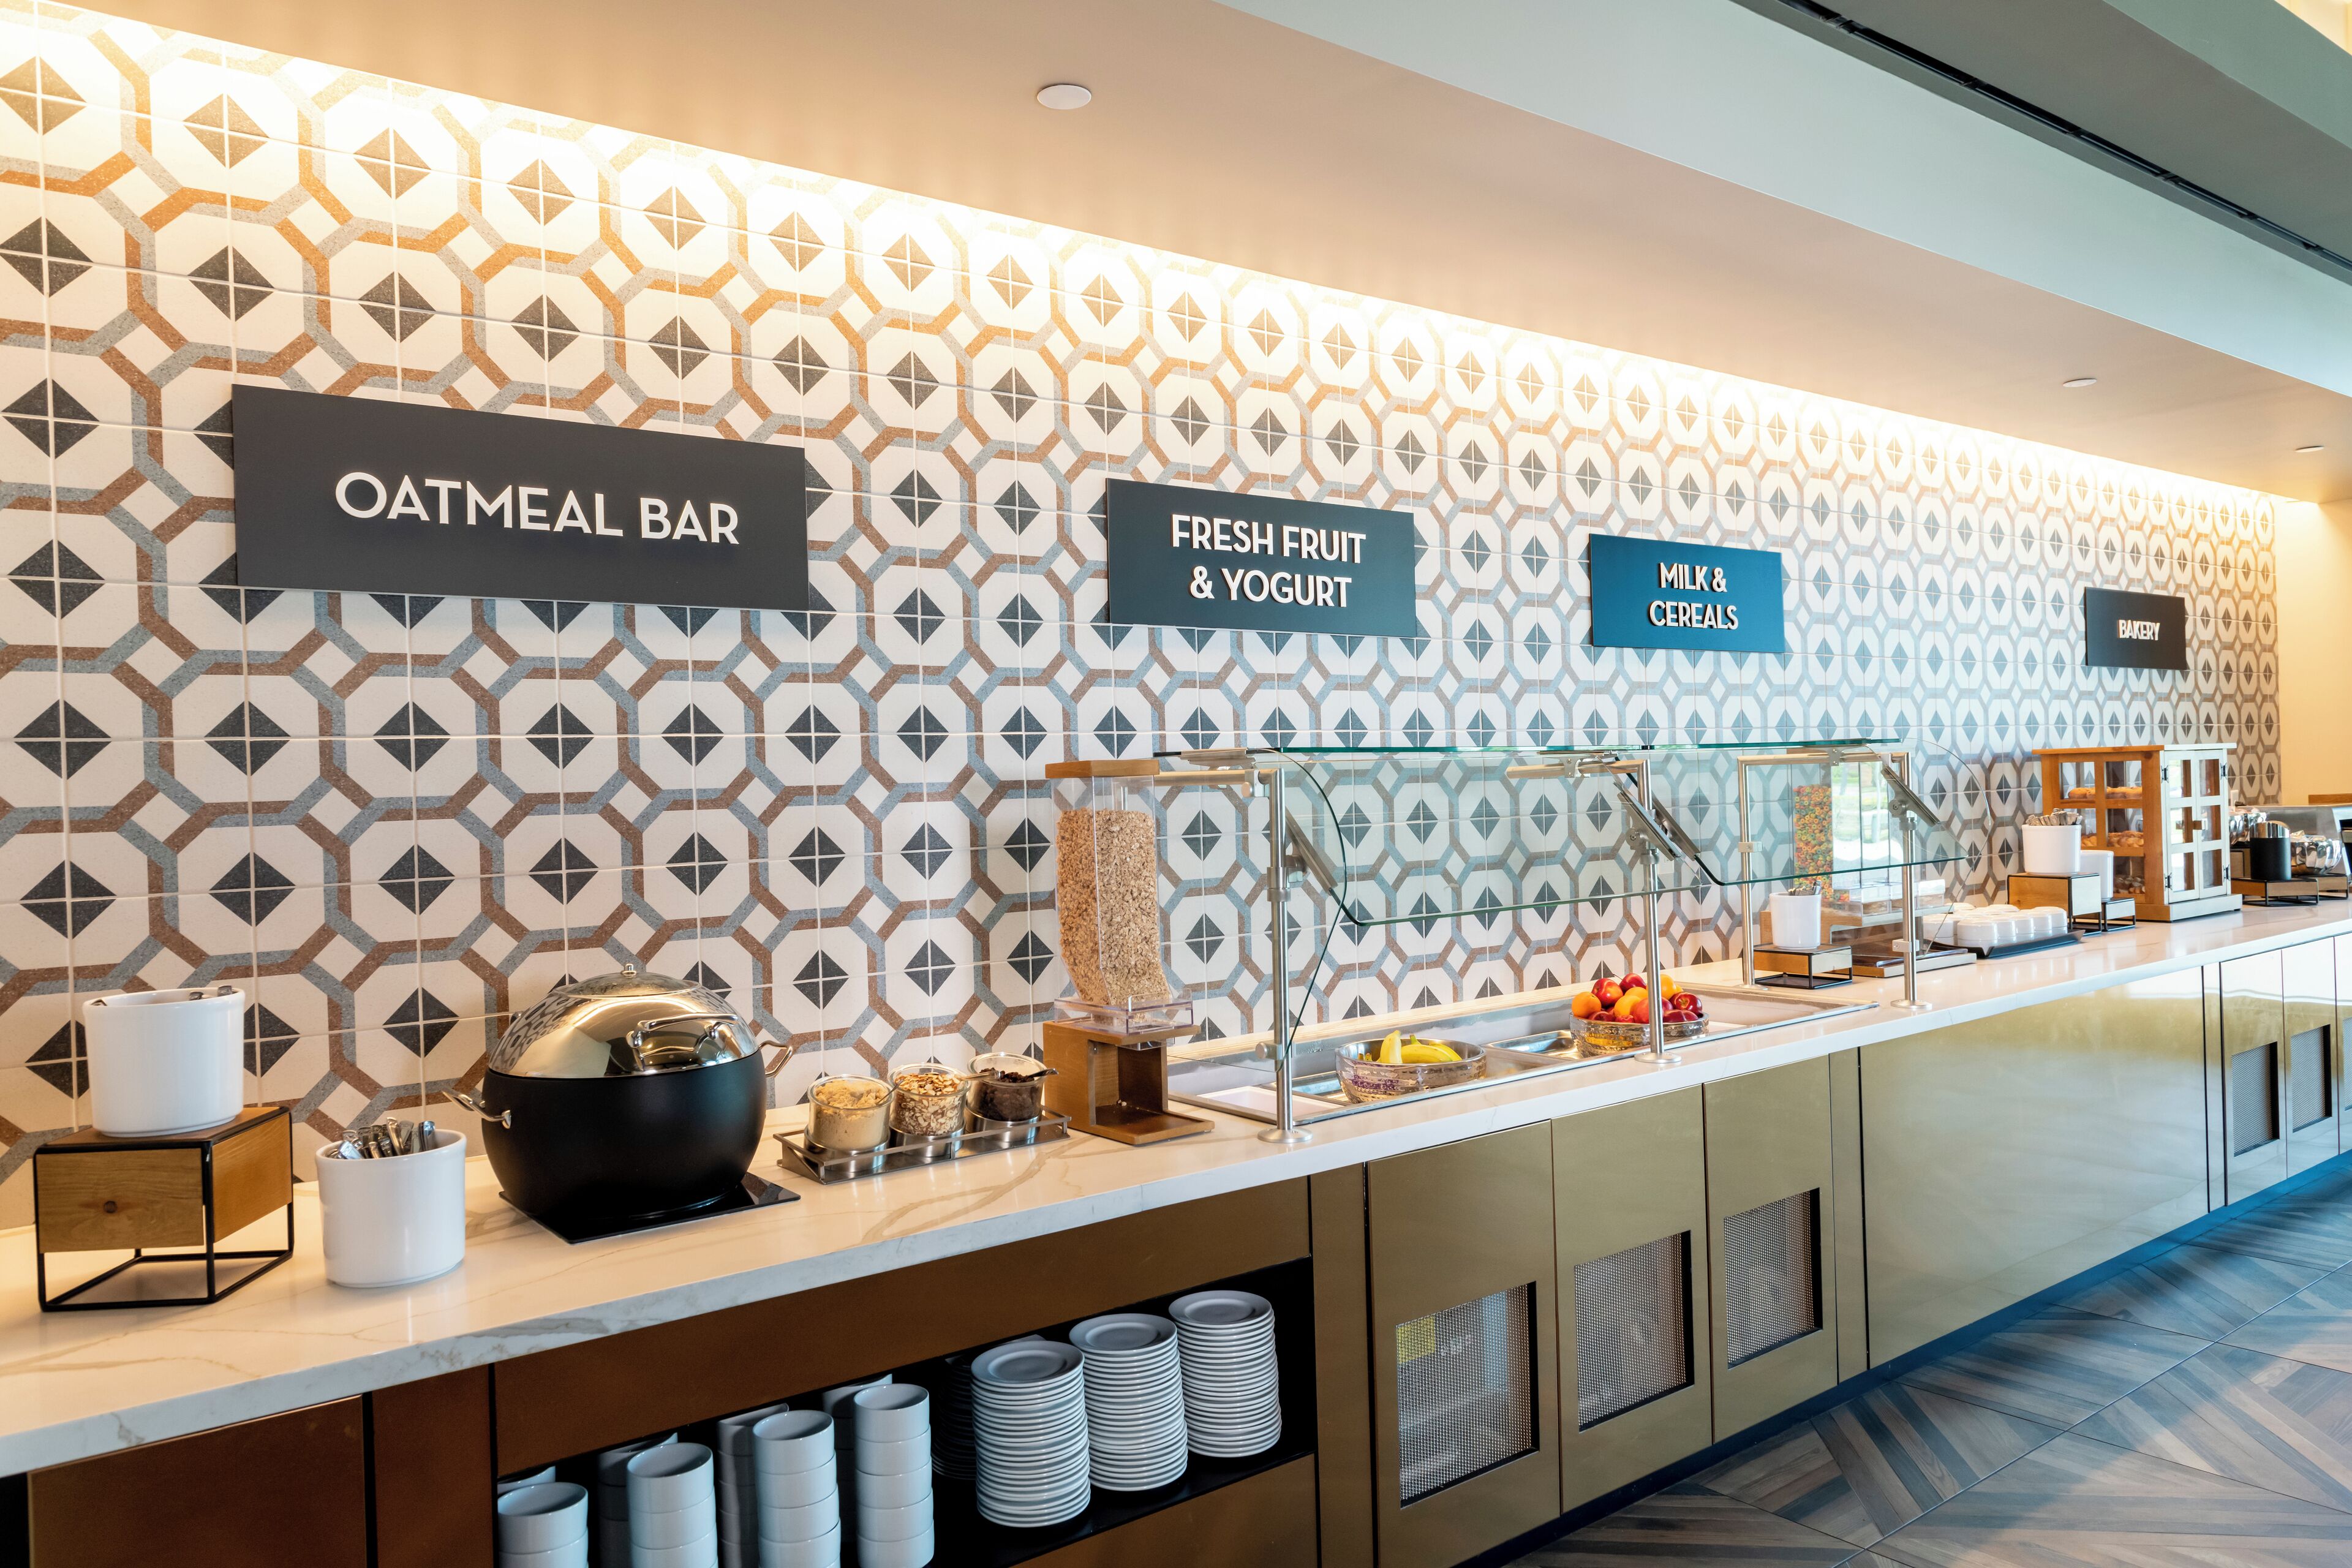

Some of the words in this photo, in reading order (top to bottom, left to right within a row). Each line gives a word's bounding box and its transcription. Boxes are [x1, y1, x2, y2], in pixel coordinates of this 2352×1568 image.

[334, 472, 624, 537] OATMEAL
[640, 497, 739, 545] BAR
[1171, 513, 1274, 555] FRESH
[1283, 525, 1366, 564] FRUIT
[1189, 565, 1215, 600] &
[1221, 568, 1352, 608] YOGURT
[1659, 562, 1709, 591] MILK
[1712, 567, 1727, 593] &
[1649, 600, 1739, 630] CEREALS
[2117, 619, 2160, 641] BAKERY
